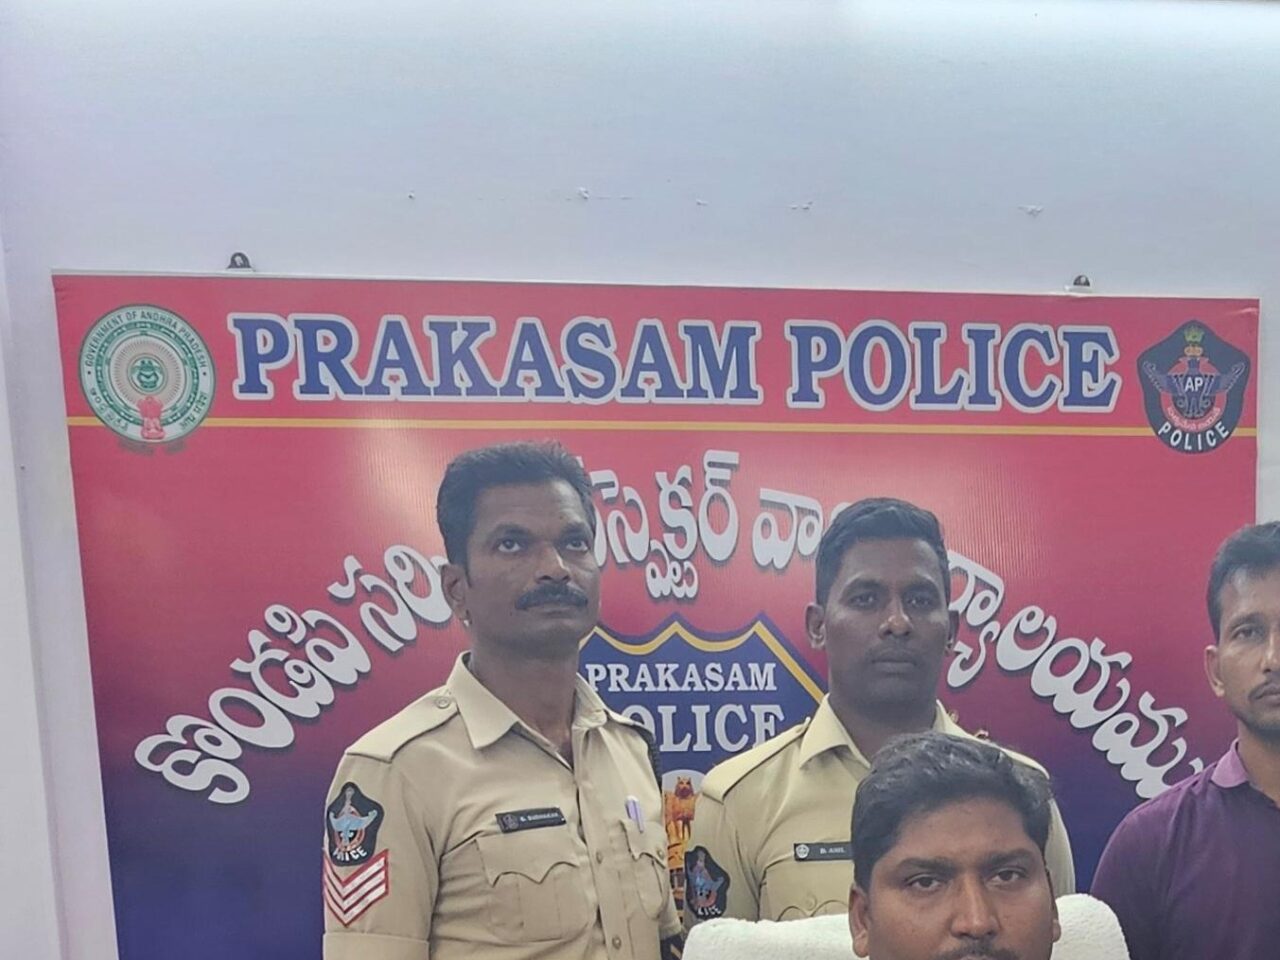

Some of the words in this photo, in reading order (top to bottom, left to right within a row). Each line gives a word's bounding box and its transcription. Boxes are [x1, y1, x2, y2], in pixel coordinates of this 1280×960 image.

[84, 315, 126, 367] GOVERNMENT
[125, 310, 138, 321] OF
[140, 310, 178, 331] ANDHRA
[178, 327, 208, 368] PRADESH
[230, 315, 762, 403] PRAKASAM
[786, 321, 1121, 411] POLICE
[1184, 376, 1204, 393] AP
[1157, 421, 1230, 451] POLICE
[585, 663, 778, 693] PRAKASAM
